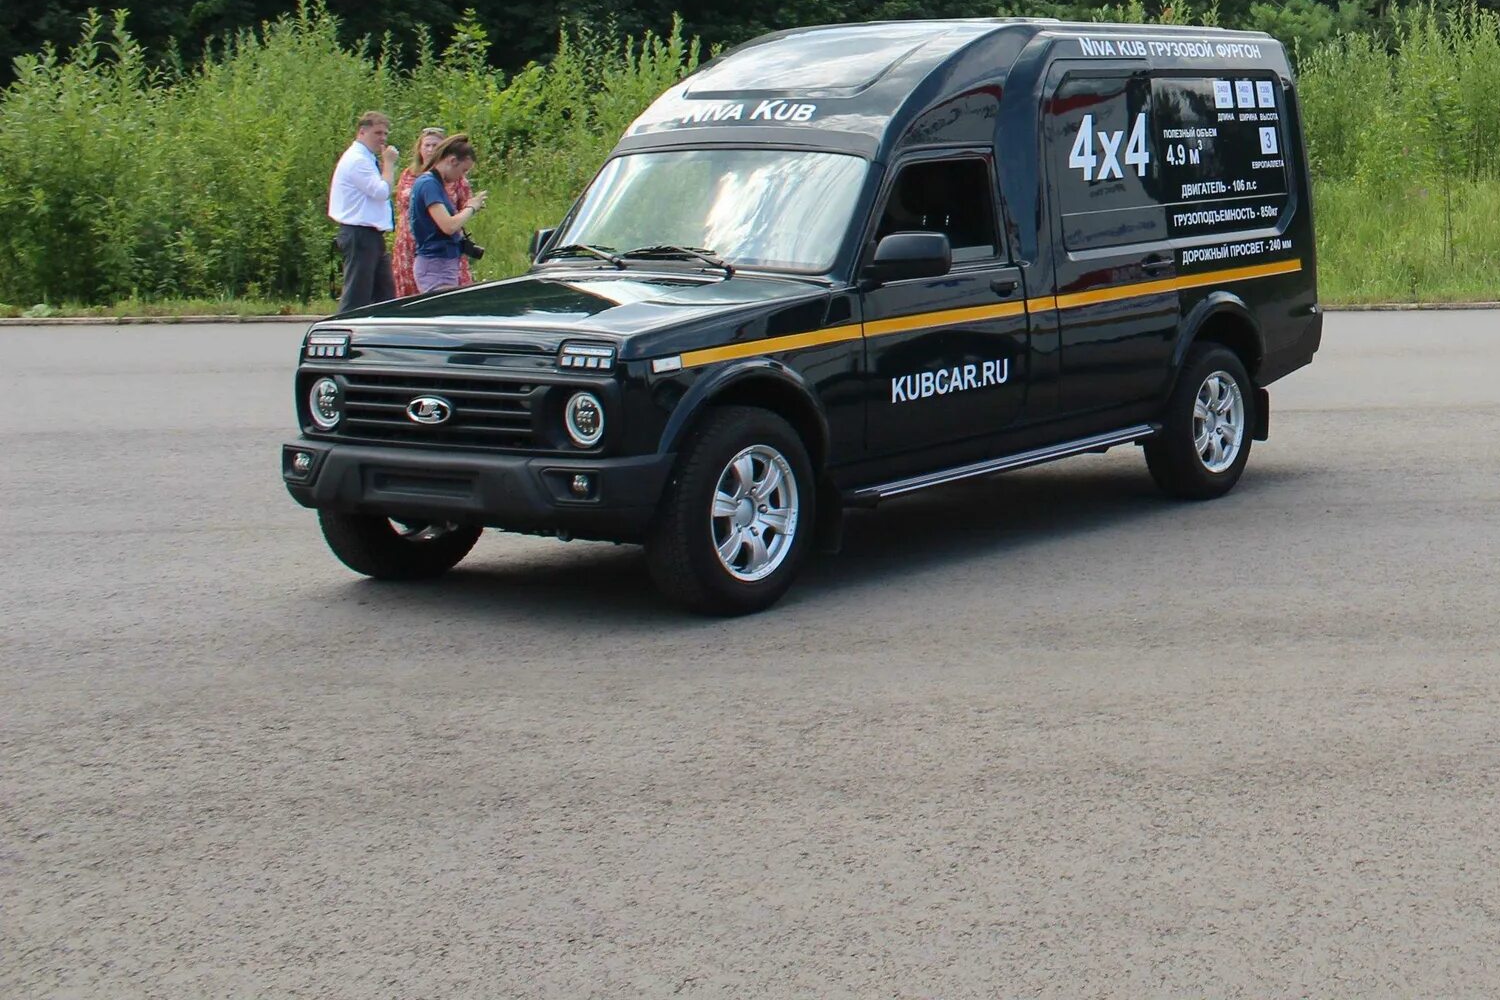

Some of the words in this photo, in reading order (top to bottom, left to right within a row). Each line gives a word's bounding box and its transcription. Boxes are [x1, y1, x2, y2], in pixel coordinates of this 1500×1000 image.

[1117, 40, 1147, 56] KUB
[1147, 40, 1214, 58] ГРУЗОВОЙ
[1216, 43, 1262, 59] ФУРГОН
[1259, 112, 1279, 121] ВЫСОТА
[1163, 127, 1195, 139] ПОЛЕЗНЫЙ
[1196, 127, 1217, 138] ОБЪЕМ
[1265, 131, 1272, 149] 3
[1068, 112, 1149, 182] 4x4
[1166, 144, 1186, 166] 4.9
[1181, 181, 1226, 199] ДВИГАТЕЛЬ
[1232, 180, 1245, 192] 106
[1173, 207, 1255, 227] ГРУЗОПОДЪЕМНОСТЬ
[1182, 244, 1229, 265] ДОРОЖНЫЙ
[1230, 241, 1264, 257] ПРОСВЕТ
[1269, 239, 1281, 251] 240
[891, 358, 1008, 404] KUBCAR.RU
